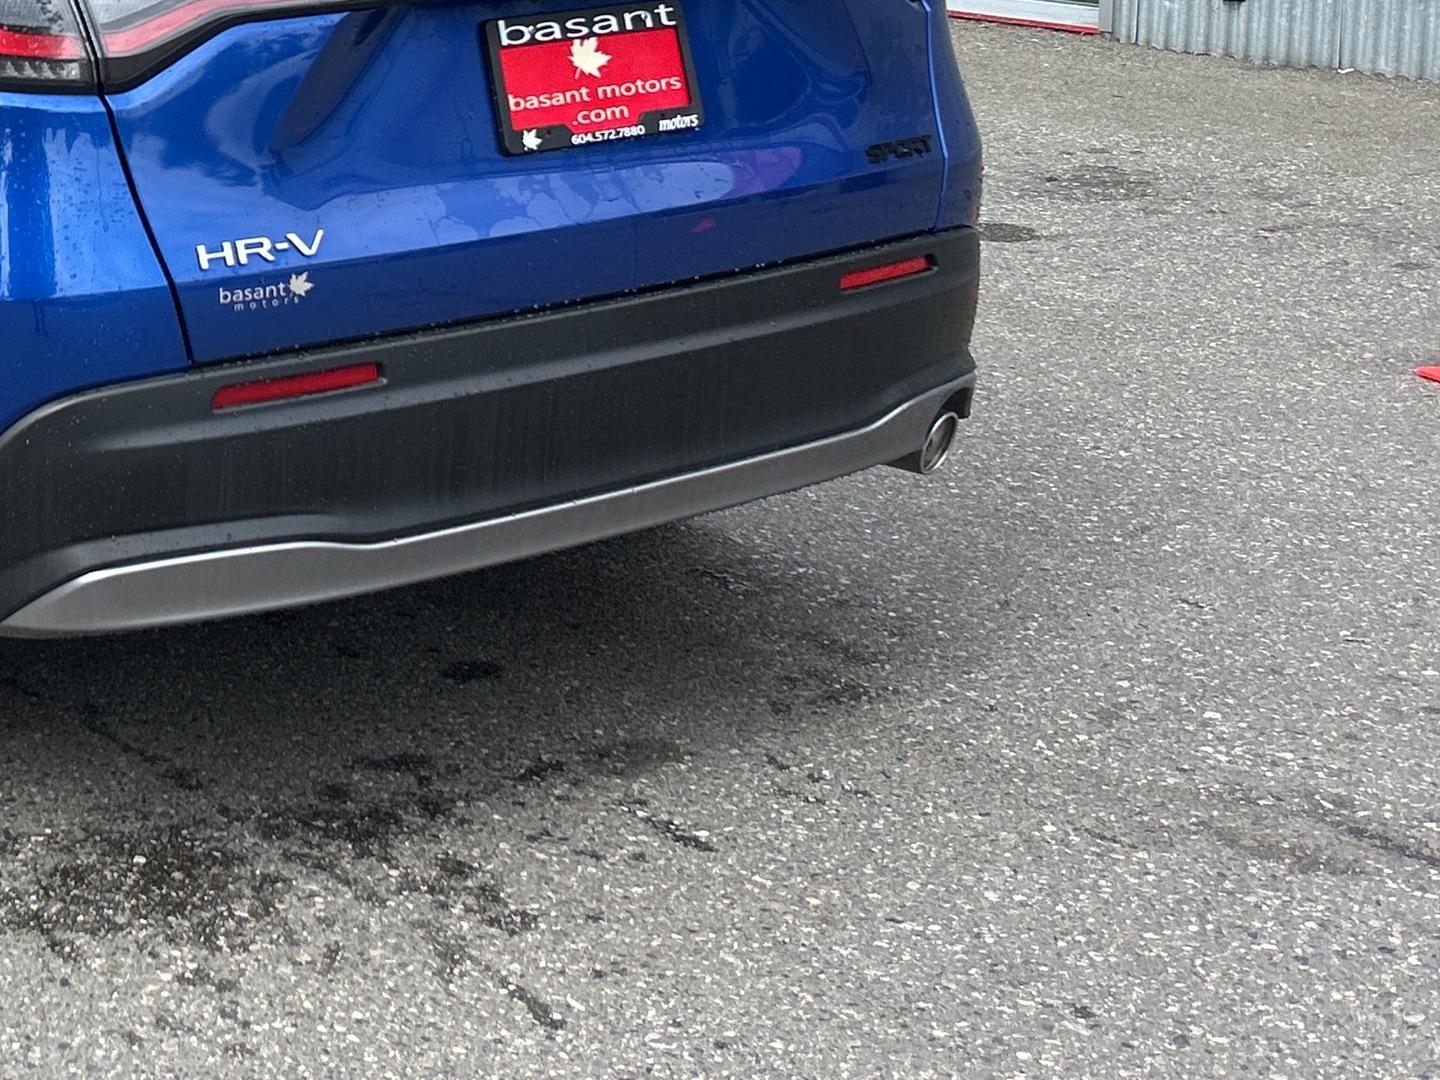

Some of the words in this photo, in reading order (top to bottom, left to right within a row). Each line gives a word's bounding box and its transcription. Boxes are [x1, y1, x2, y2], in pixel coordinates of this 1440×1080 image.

[498, 4, 676, 46] basant
[508, 85, 591, 112] basant
[597, 76, 682, 100] motors
[571, 104, 630, 126] .com
[658, 113, 699, 132] motors
[572, 125, 645, 145] 604.572.7880
[196, 229, 324, 270] HR-V
[219, 282, 287, 305] basant
[235, 296, 299, 311] motors
